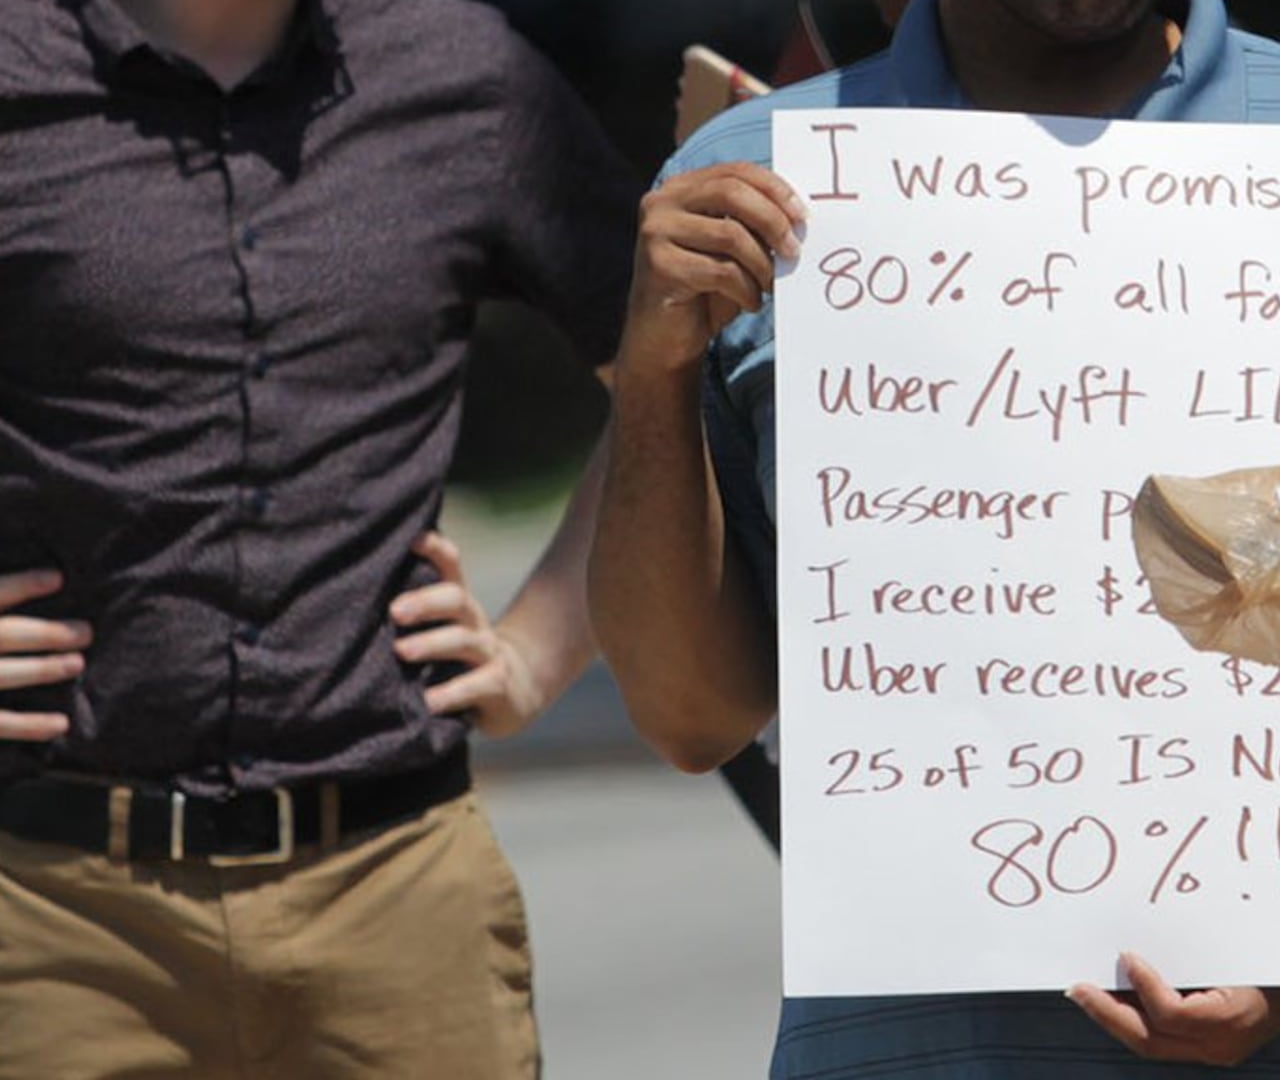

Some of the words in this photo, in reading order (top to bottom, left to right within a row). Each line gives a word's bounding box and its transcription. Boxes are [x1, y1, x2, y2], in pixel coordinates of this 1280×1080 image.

[809, 123, 859, 201] I
[892, 156, 1029, 201] was
[818, 246, 973, 311] 80%
[1001, 252, 1077, 312] of
[1114, 258, 1189, 315] all
[816, 466, 1070, 540] Passenger
[807, 558, 851, 624] I
[871, 567, 1057, 616] receive
[820, 641, 947, 697] Uber
[976, 658, 1189, 700] receives
[823, 748, 904, 796] 25
[923, 744, 982, 790] of
[1007, 742, 1085, 789] 50
[1118, 733, 1197, 786] IS
